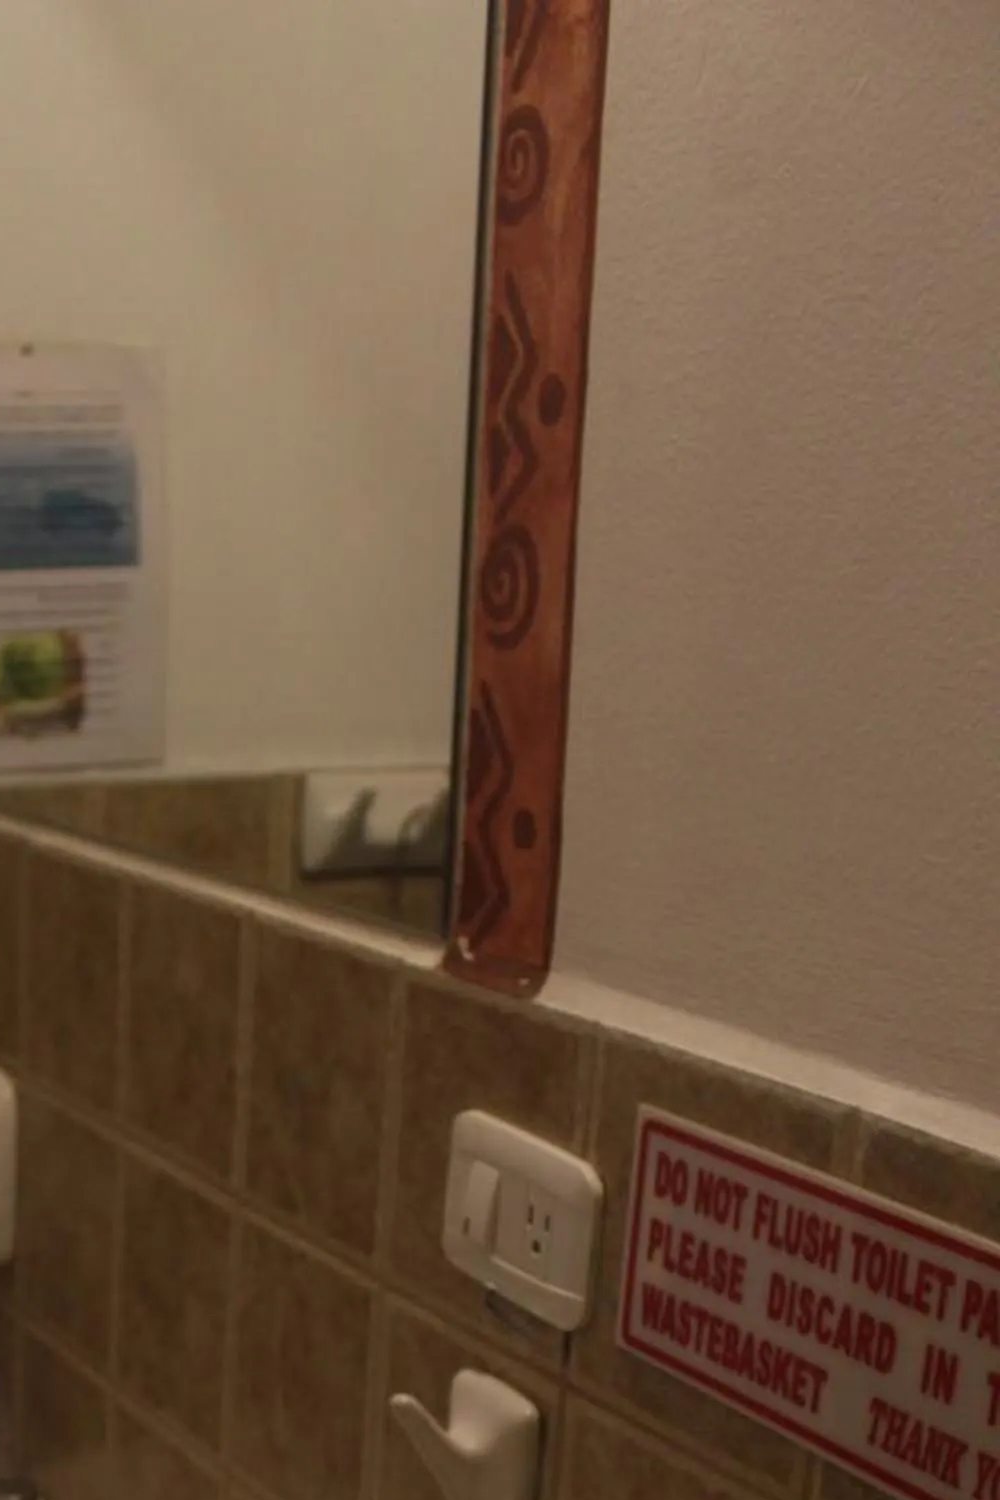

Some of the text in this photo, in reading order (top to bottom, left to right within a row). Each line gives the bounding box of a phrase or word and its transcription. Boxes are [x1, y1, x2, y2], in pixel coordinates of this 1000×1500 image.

[648, 1219, 746, 1299] PLEASE
[767, 1274, 896, 1373] DISCARD
[921, 1344, 959, 1405] IN
[655, 1152, 687, 1206] DO
[695, 1170, 749, 1231] NOT
[754, 1194, 842, 1273] FLUSH
[852, 1233, 956, 1321] TOILET
[642, 1283, 828, 1413] WASTEBASKET
[868, 1398, 968, 1488] THANK
